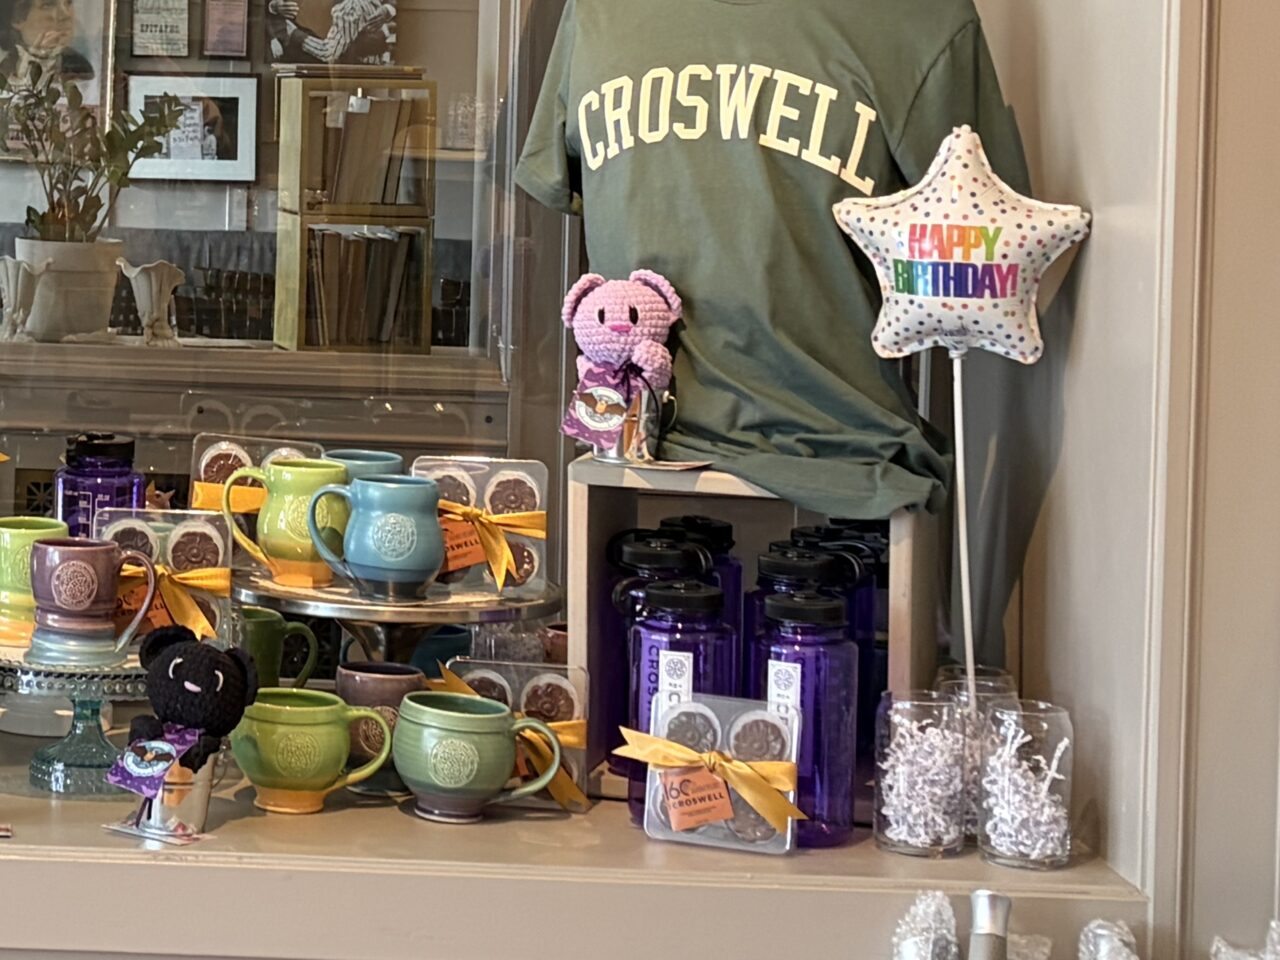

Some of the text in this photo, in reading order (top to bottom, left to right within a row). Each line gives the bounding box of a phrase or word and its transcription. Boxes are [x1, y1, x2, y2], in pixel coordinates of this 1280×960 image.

[576, 62, 880, 196] CROSWELL
[907, 223, 1004, 262] HAPPY
[892, 258, 1020, 299] BIRTHDAY!
[446, 538, 480, 552] SWELL
[671, 792, 725, 809] CROSWELL
